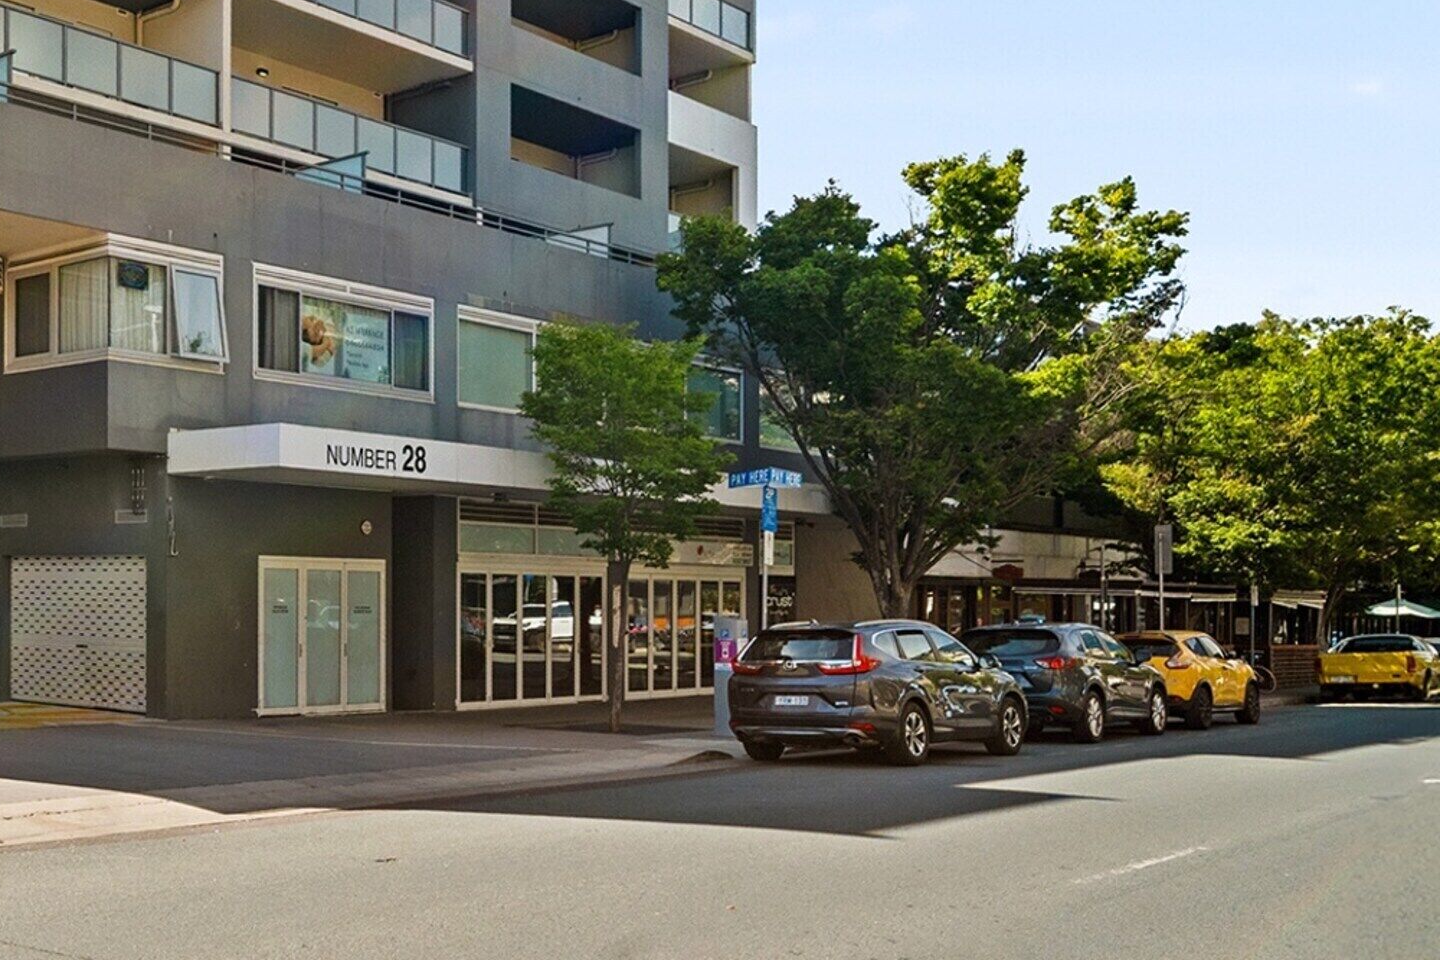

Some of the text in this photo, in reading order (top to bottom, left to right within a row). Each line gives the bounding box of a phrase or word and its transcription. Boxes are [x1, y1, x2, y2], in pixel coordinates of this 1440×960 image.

[326, 444, 427, 473] NUMBER 28
[730, 467, 769, 485] PAY HERE
